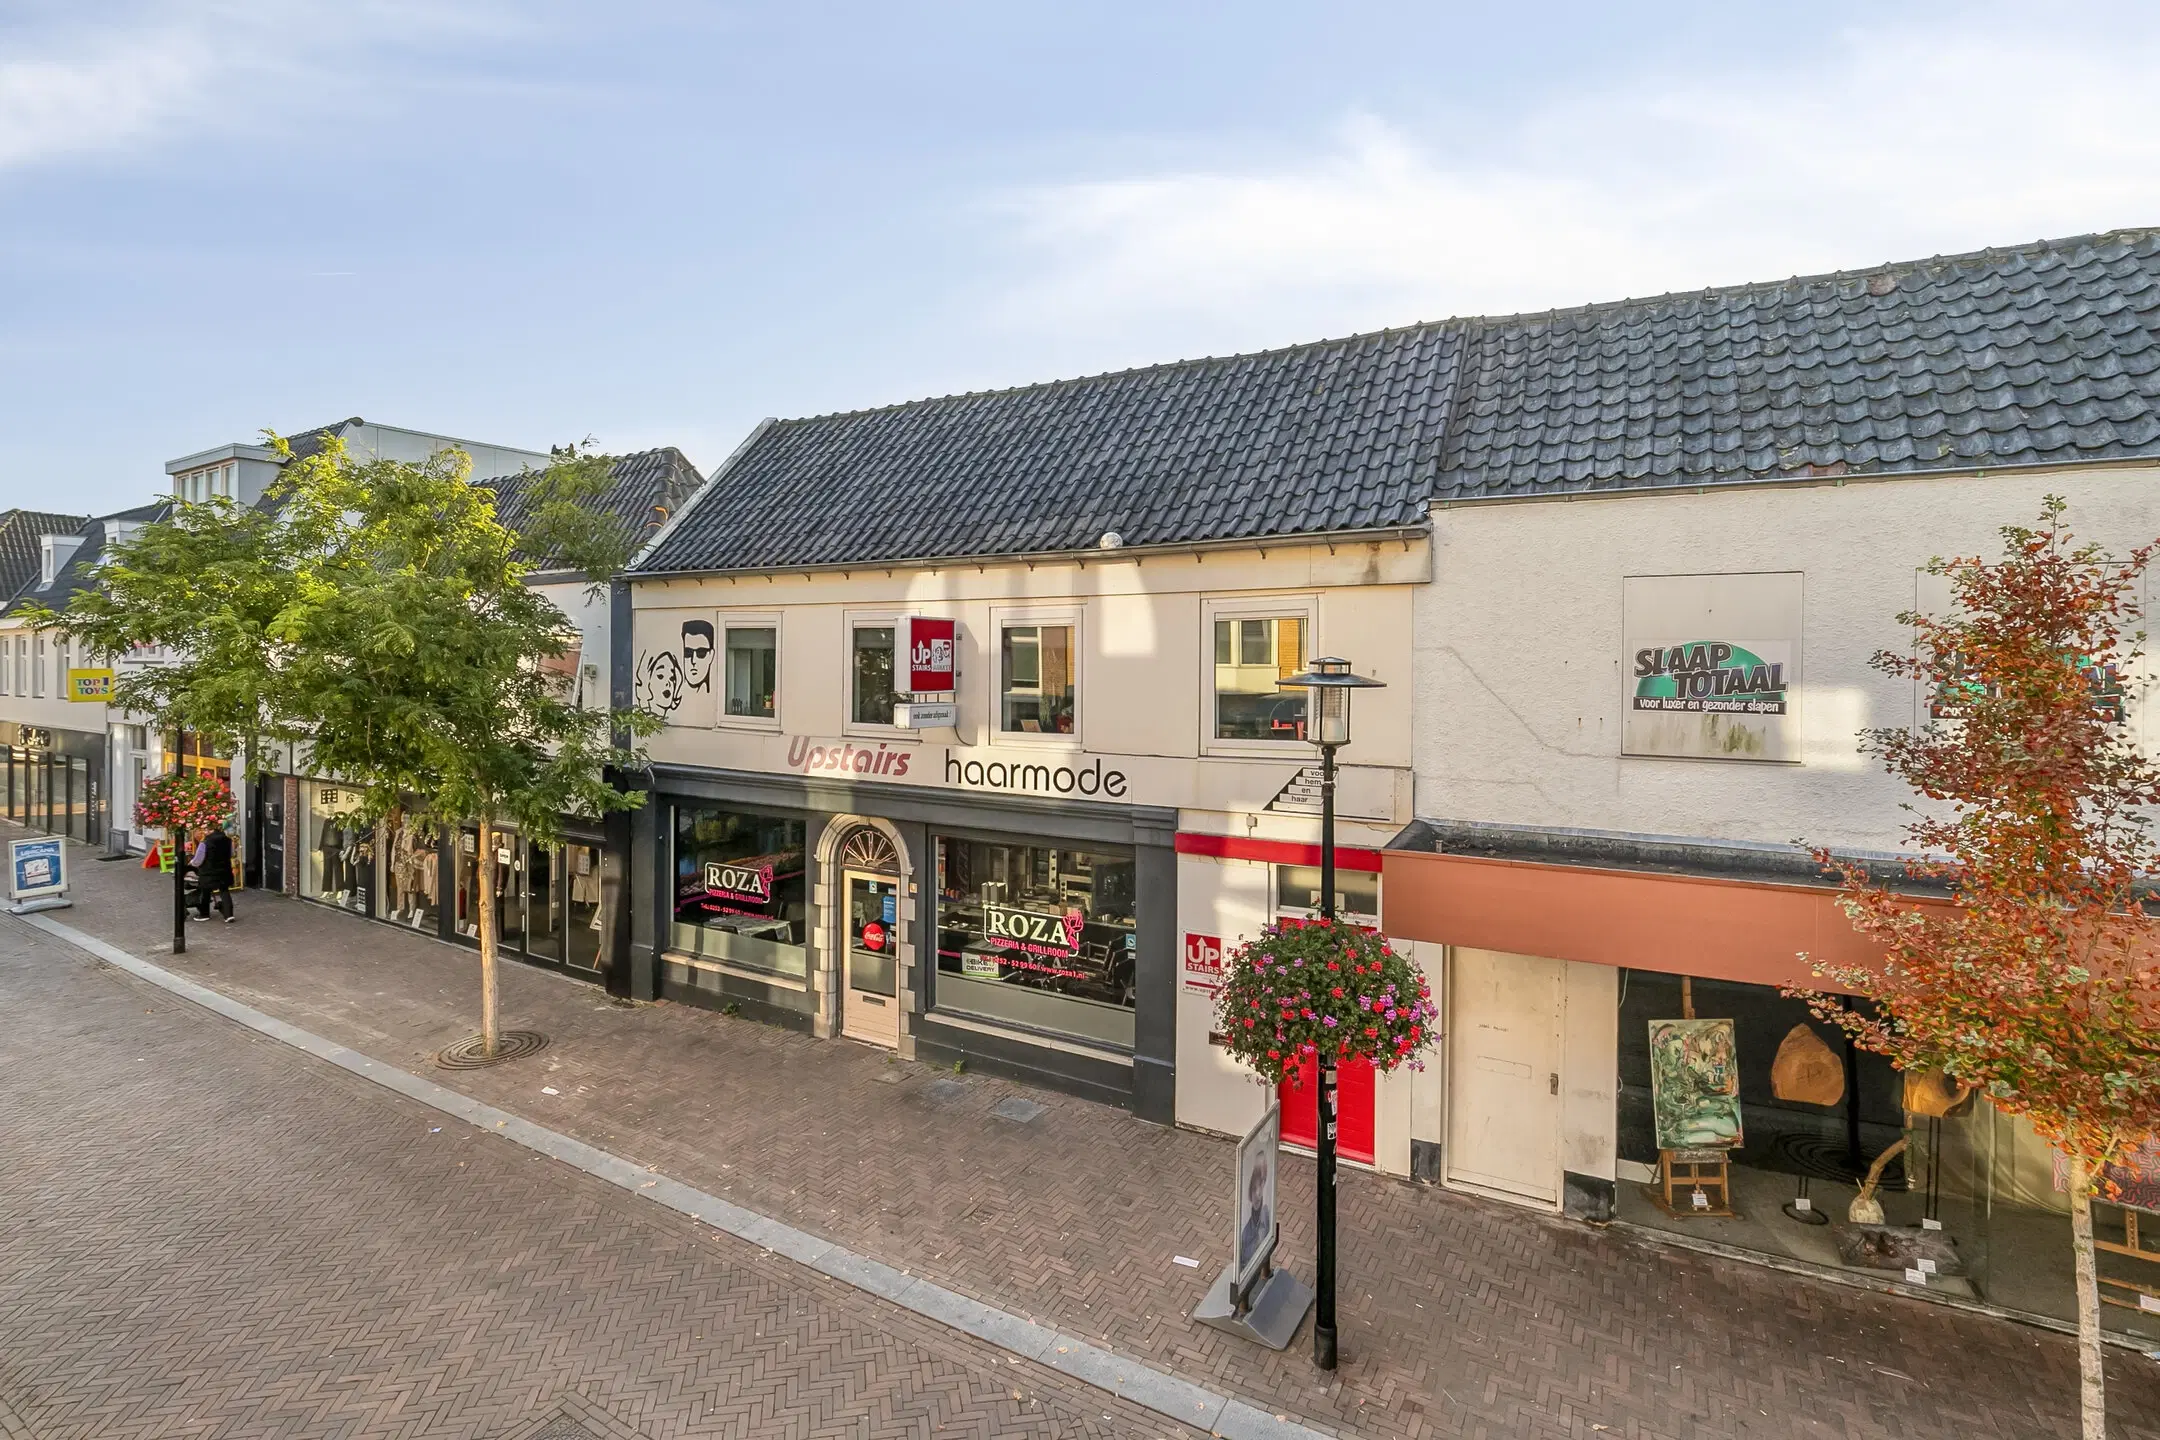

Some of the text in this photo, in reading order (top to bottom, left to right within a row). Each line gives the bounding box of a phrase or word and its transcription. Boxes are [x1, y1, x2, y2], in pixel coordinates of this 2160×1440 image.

[911, 639, 931, 664] UP
[1634, 641, 1733, 678] SLAAP
[911, 664, 931, 672] STAIRS
[75, 678, 101, 687] TOP
[77, 687, 109, 695] TOYS
[1673, 662, 1789, 700] TOTAAL
[1639, 697, 1779, 714] voor luxer en gezonder slapen
[788, 735, 1128, 798] Upstairs haarmode
[1291, 795, 1308, 803] haar
[707, 866, 764, 894] ROZA
[709, 888, 729, 899] PIZZERIA
[730, 892, 735, 900] &
[988, 910, 1070, 946] ROZA
[990, 936, 1069, 959] PIZZERIA & GRILLROOM
[1187, 936, 1220, 966] UP
[1011, 960, 1019, 968] 52
[1019, 961, 1028, 969] 99
[1028, 962, 1037, 970] 60
[1187, 962, 1220, 975] STAIRS
